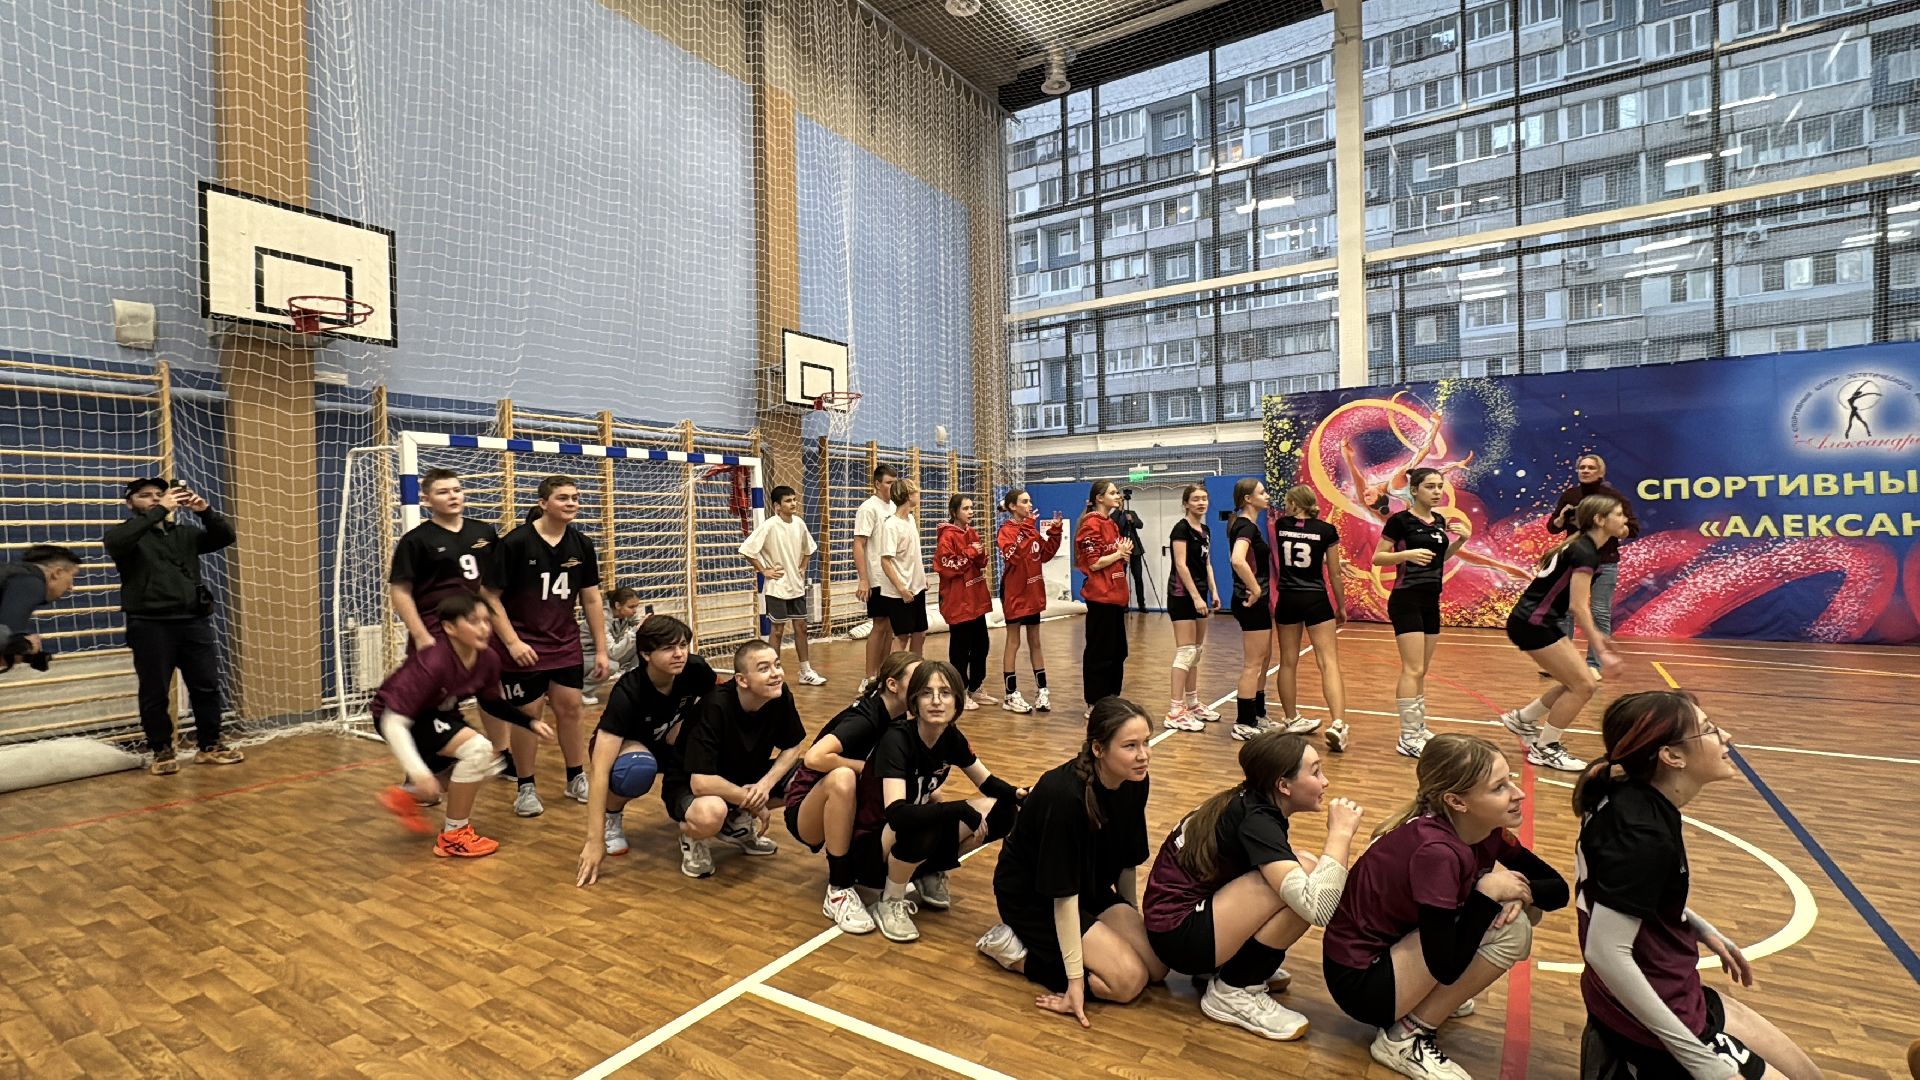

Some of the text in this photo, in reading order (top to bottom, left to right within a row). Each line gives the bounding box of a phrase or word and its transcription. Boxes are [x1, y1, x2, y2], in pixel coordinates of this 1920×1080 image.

[1636, 469, 1919, 500] СПОРТИВНЫ
[459, 554, 480, 580] 9
[1282, 540, 1312, 568] 13
[540, 572, 571, 600] 14
[505, 683, 525, 699] 14
[433, 718, 452, 734] 4
